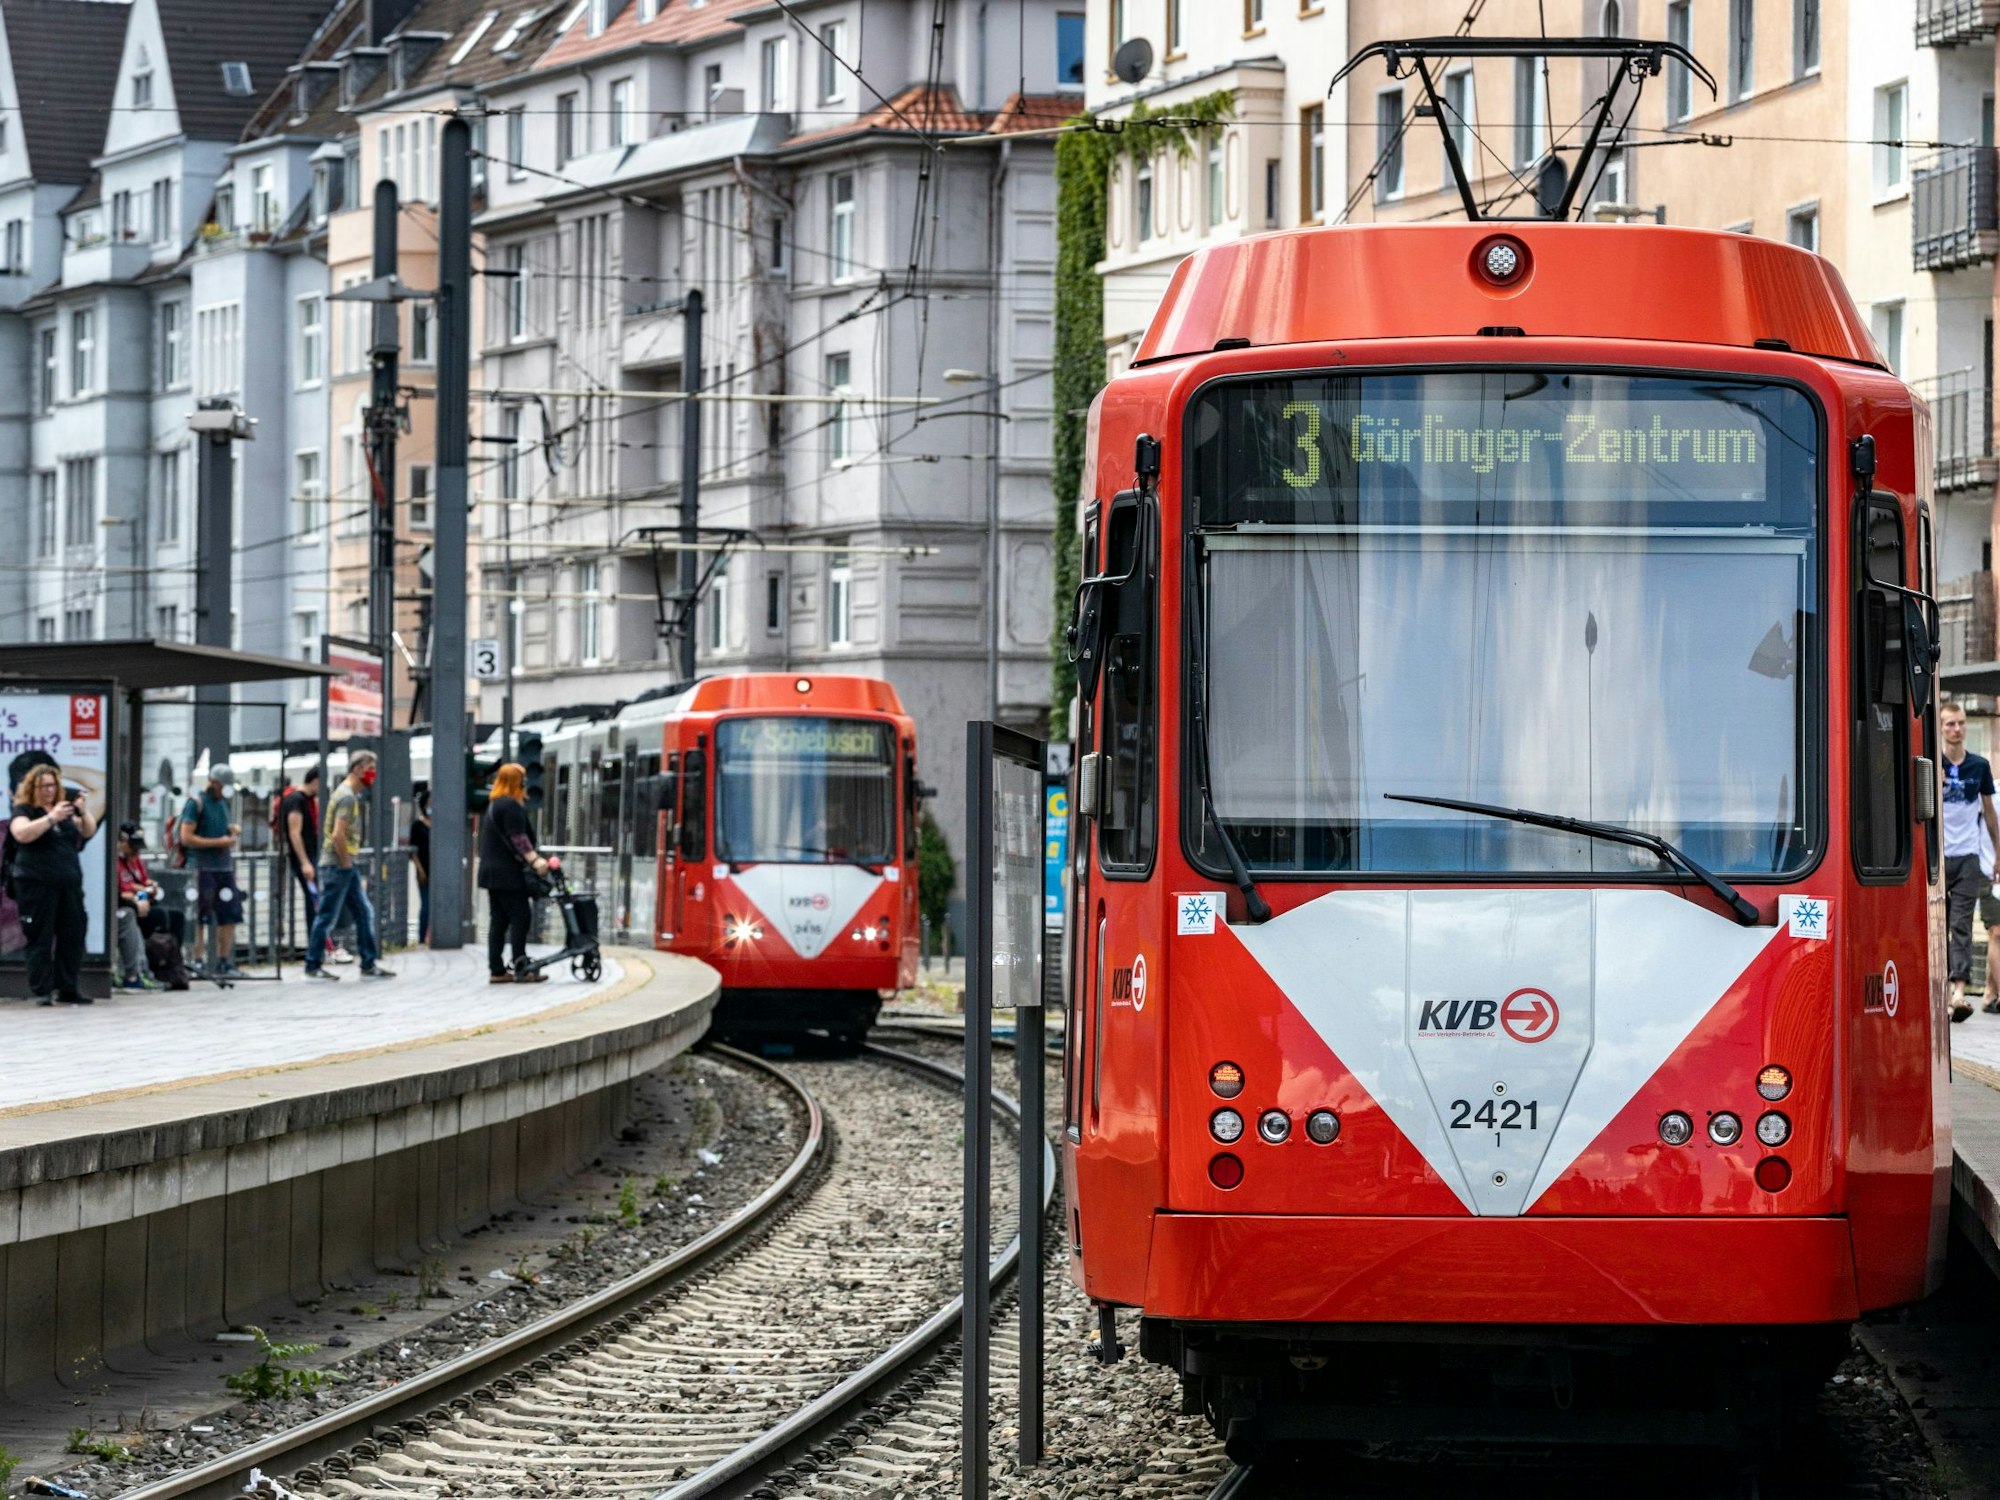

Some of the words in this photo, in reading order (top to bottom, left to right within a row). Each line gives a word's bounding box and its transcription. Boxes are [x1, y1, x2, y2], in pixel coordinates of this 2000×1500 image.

[1282, 400, 1320, 488] 3
[1351, 414, 1756, 474] Görlinger-Zentrum
[478, 650, 495, 674] 3
[0, 708, 18, 728] 's
[1112, 968, 1132, 999] KVB
[1864, 975, 1883, 1006] KVB
[1418, 1000, 1498, 1030] KVB
[1450, 1099, 1538, 1130] 2421
[1494, 1131, 1501, 1148] 1
